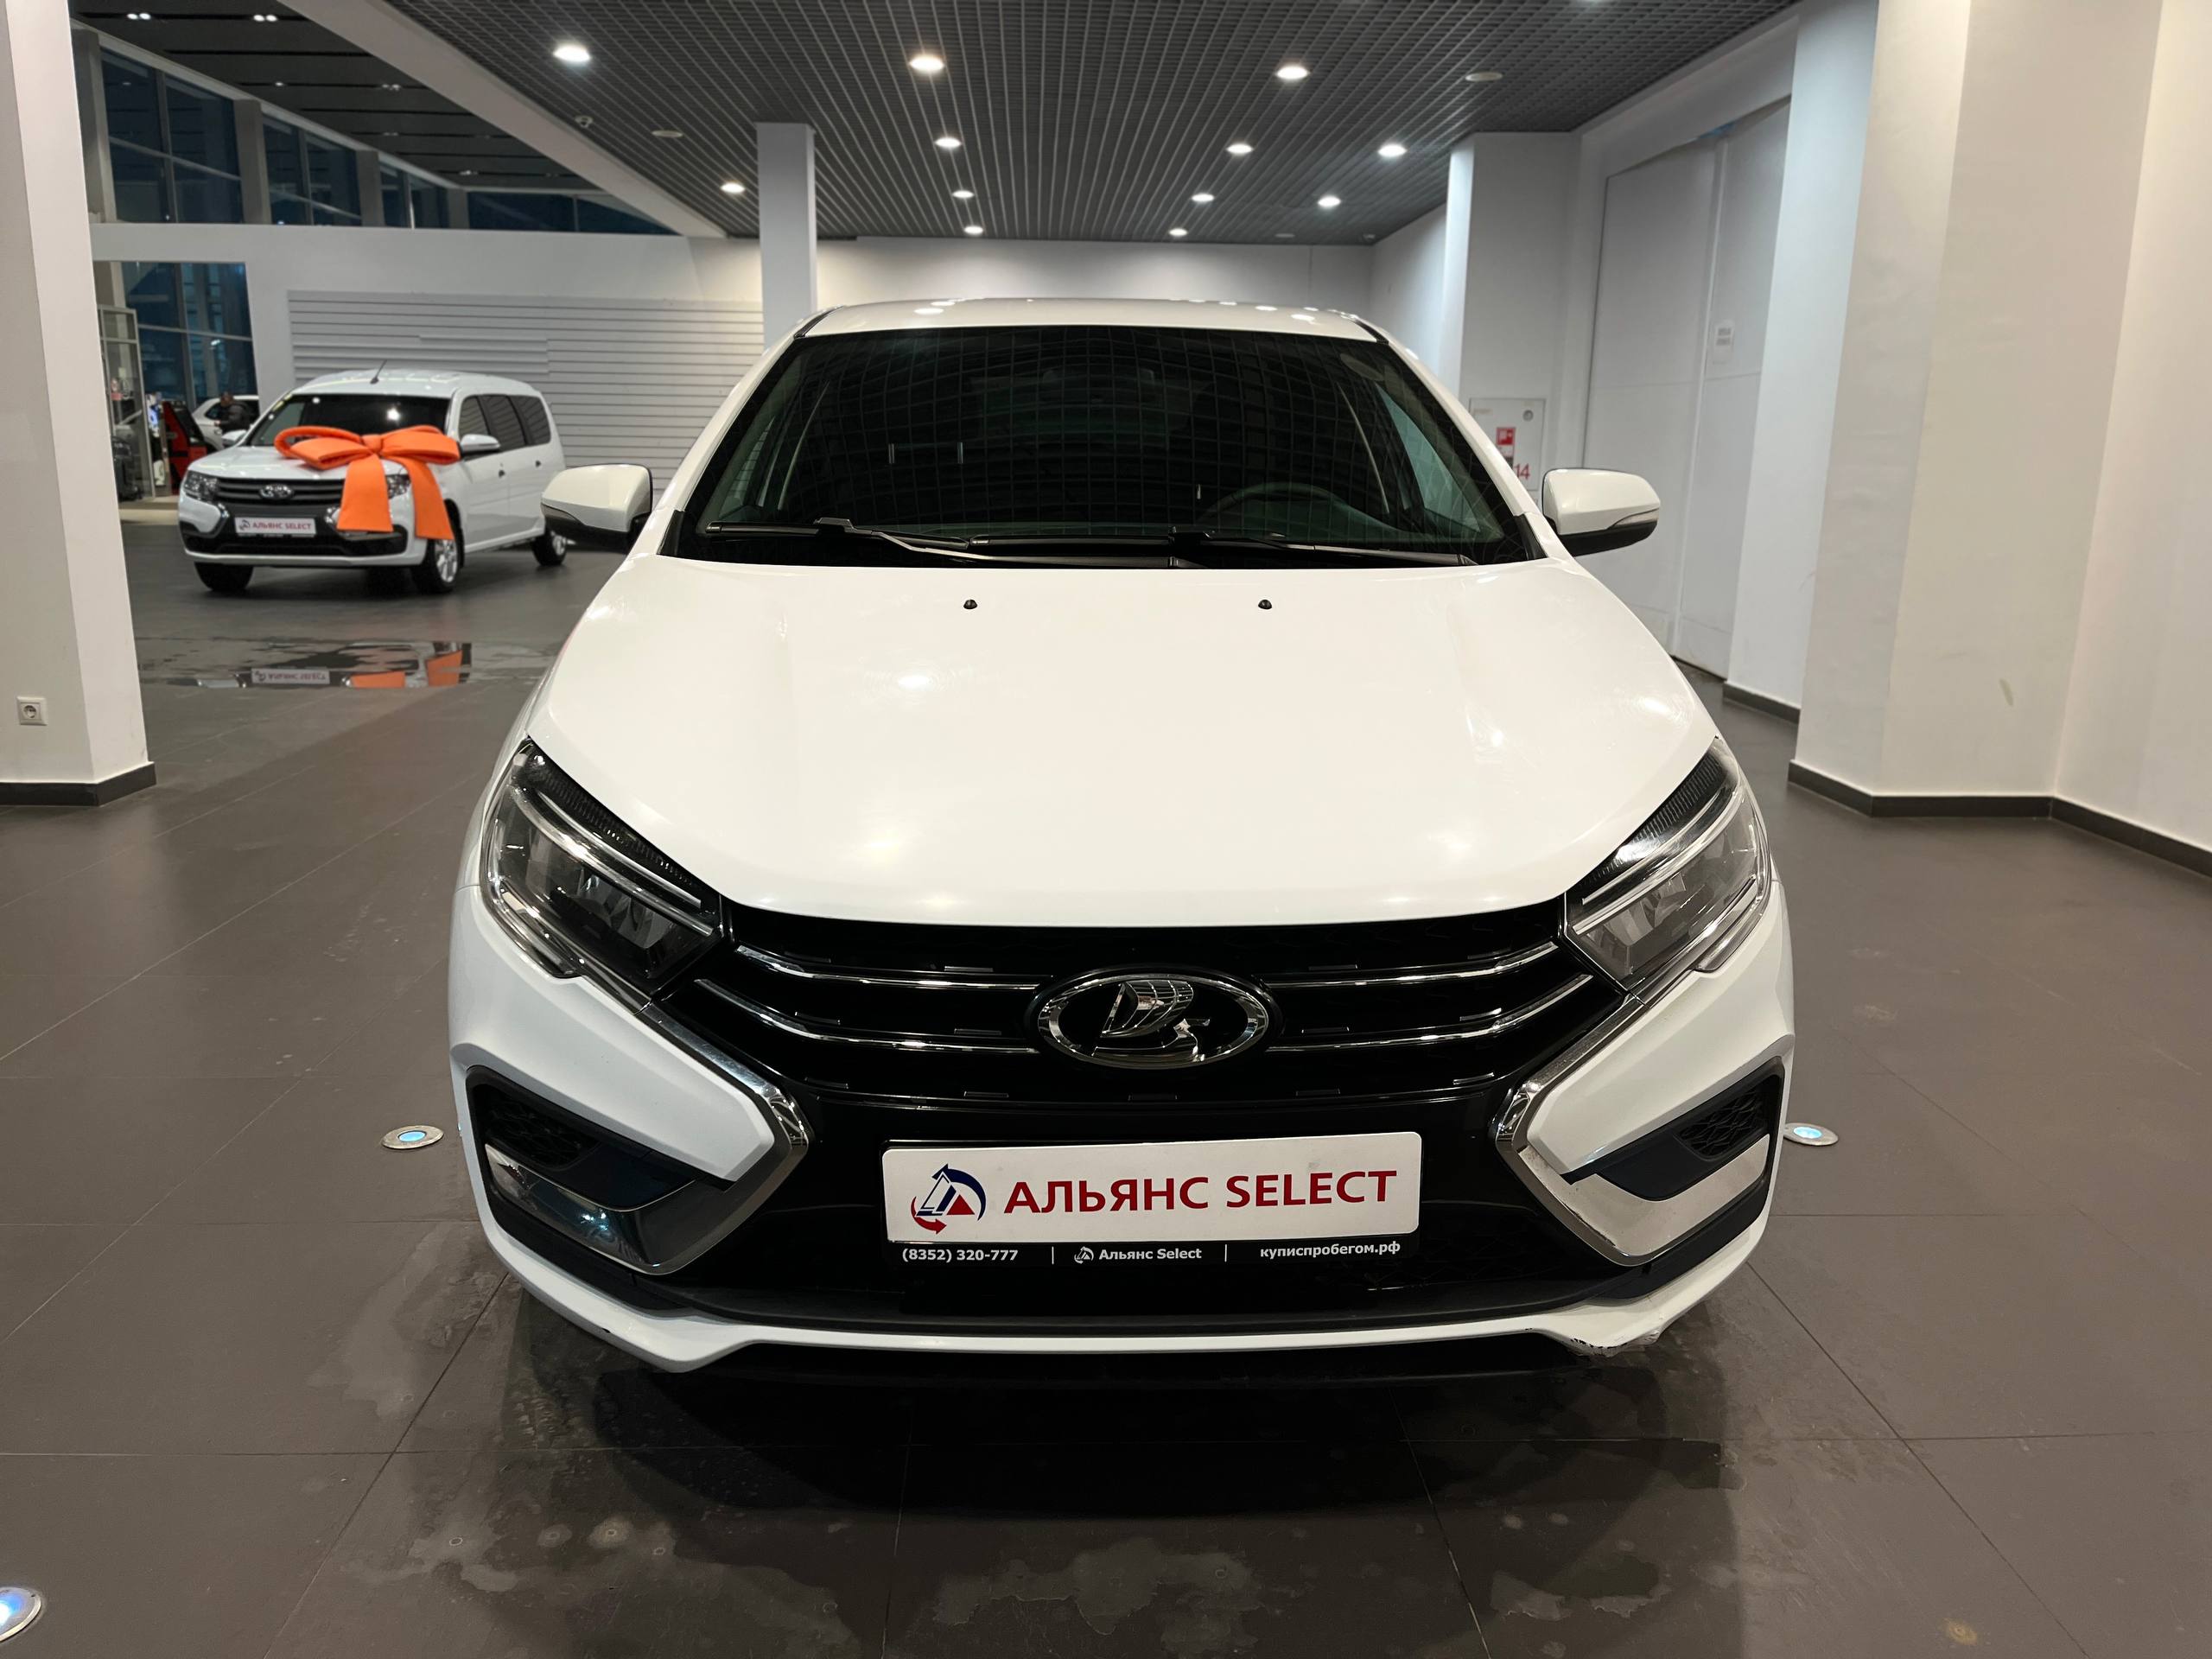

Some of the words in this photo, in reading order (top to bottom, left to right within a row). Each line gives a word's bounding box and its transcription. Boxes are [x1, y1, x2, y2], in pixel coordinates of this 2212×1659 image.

[1003, 1177, 1209, 1214] АЛЬЯНС
[1226, 1170, 1397, 1208] SELECT
[902, 1248, 952, 1263] (8352)
[957, 1249, 1018, 1262] 320-777
[1098, 1248, 1154, 1261] Альянс
[1156, 1247, 1202, 1260] Select
[1260, 1241, 1401, 1259] куписпробегом.рф
